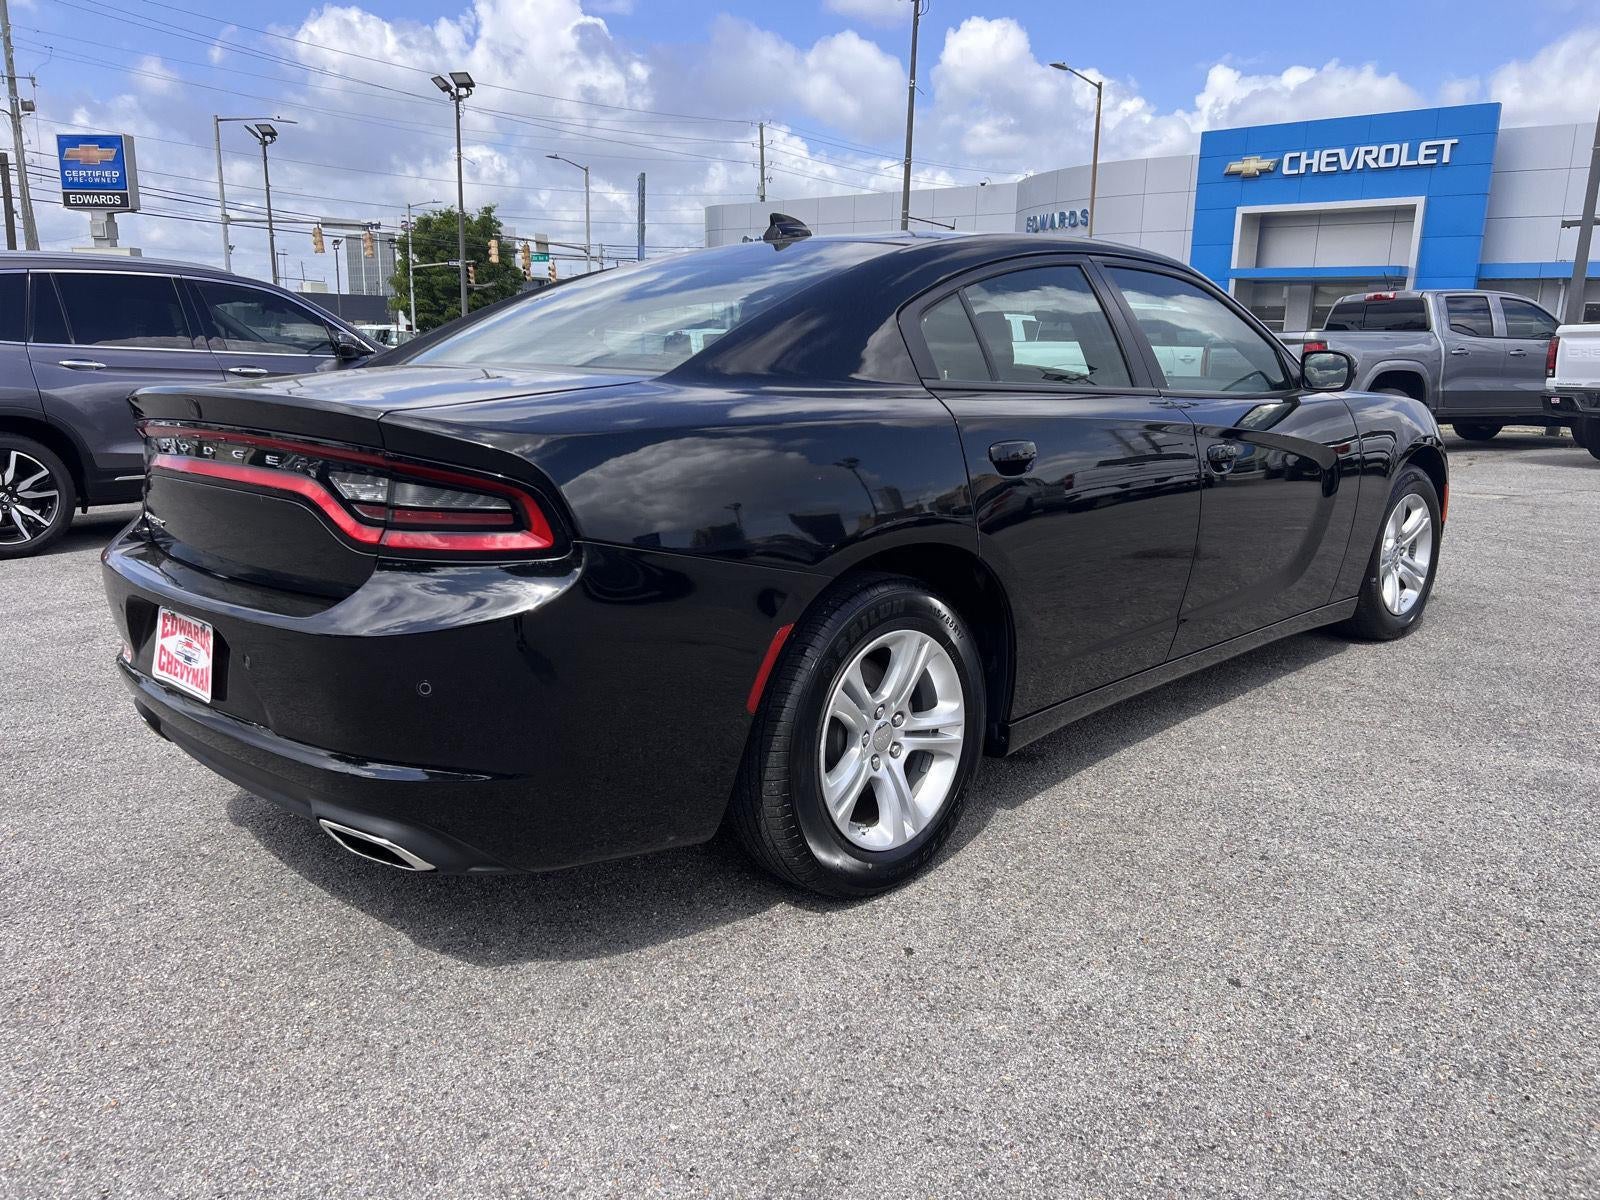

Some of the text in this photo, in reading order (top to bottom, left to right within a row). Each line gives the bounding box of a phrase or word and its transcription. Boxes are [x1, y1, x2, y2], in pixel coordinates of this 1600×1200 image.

[1282, 139, 1459, 175] CHEVROLET
[69, 195, 121, 205] EDWARDS
[1025, 208, 1089, 233] EDWARDS
[161, 612, 211, 659] EDWARDS
[158, 643, 210, 694] CHEVYMAN
